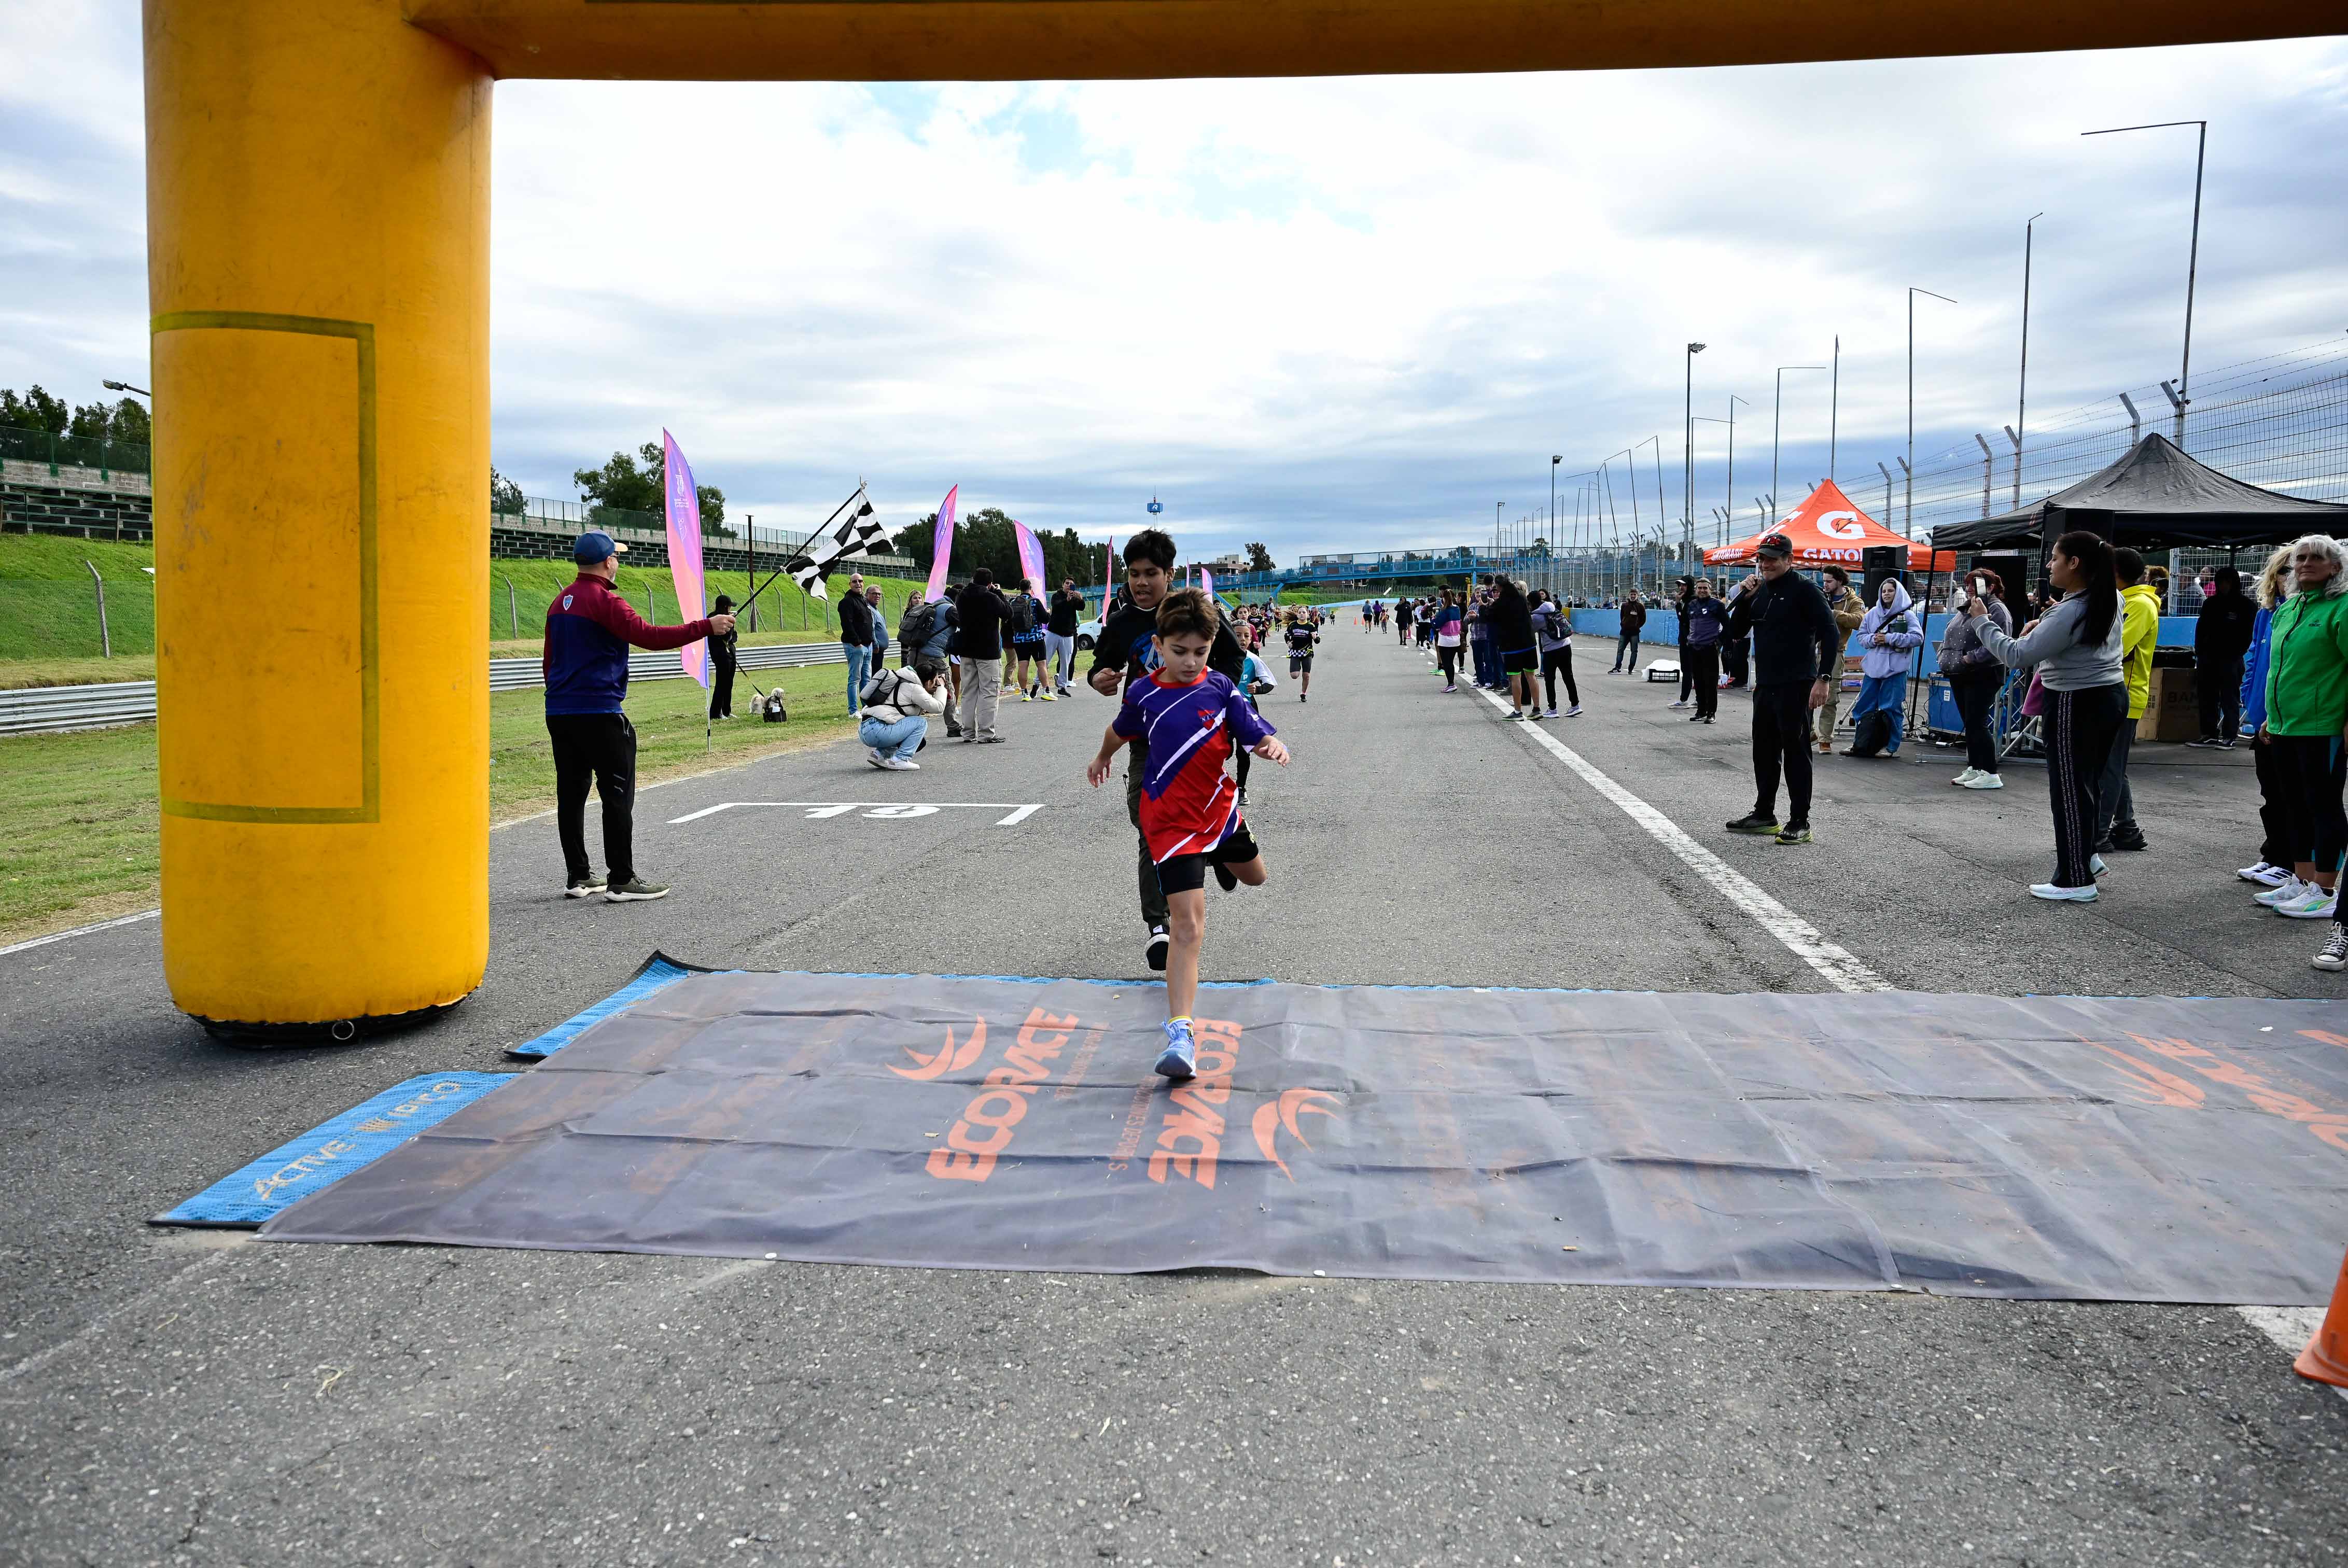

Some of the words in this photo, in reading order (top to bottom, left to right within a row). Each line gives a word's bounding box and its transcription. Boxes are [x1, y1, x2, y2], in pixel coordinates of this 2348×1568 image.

[1816, 510, 1866, 540] G
[804, 805, 941, 818] 19
[925, 1006, 1079, 1182] ECORACE
